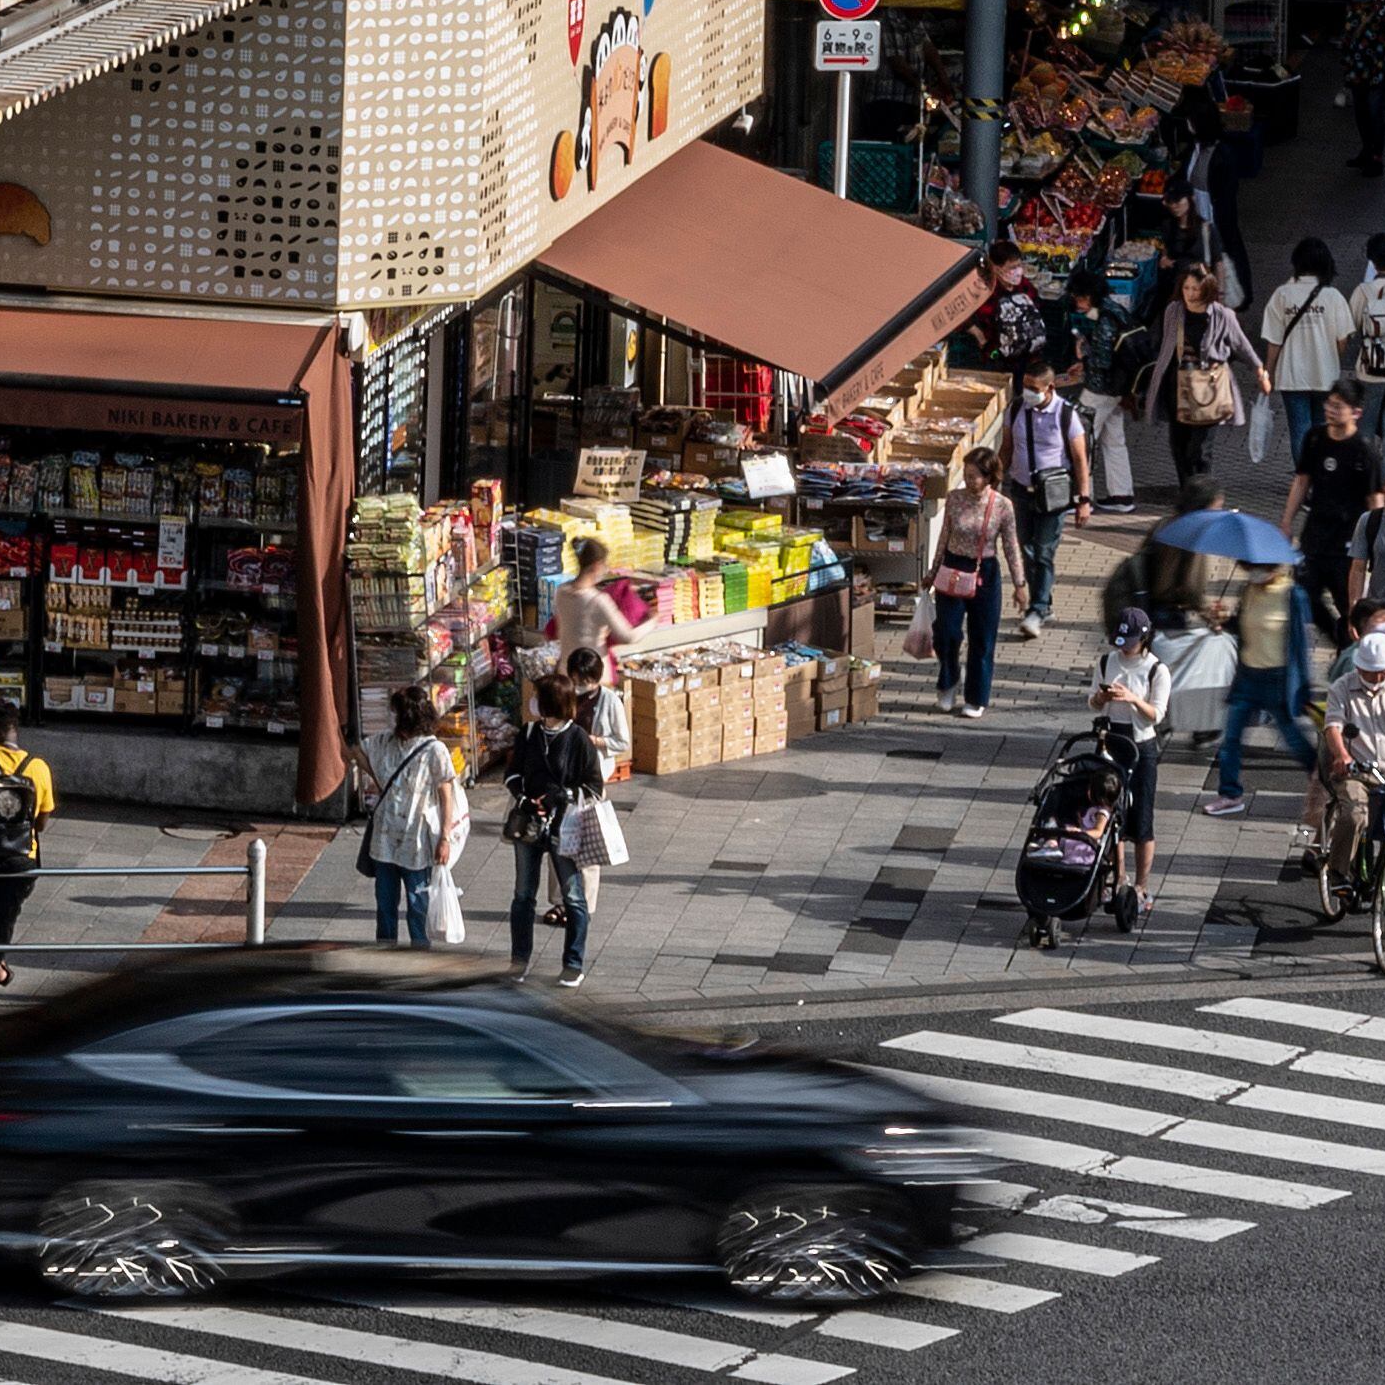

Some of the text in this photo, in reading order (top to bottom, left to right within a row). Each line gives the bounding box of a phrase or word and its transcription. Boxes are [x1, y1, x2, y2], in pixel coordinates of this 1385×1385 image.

[822, 41, 875, 55] 貨物を除く
[107, 408, 145, 426] NIKI
[150, 410, 222, 431] BAKERY
[246, 417, 294, 435] CAFE
